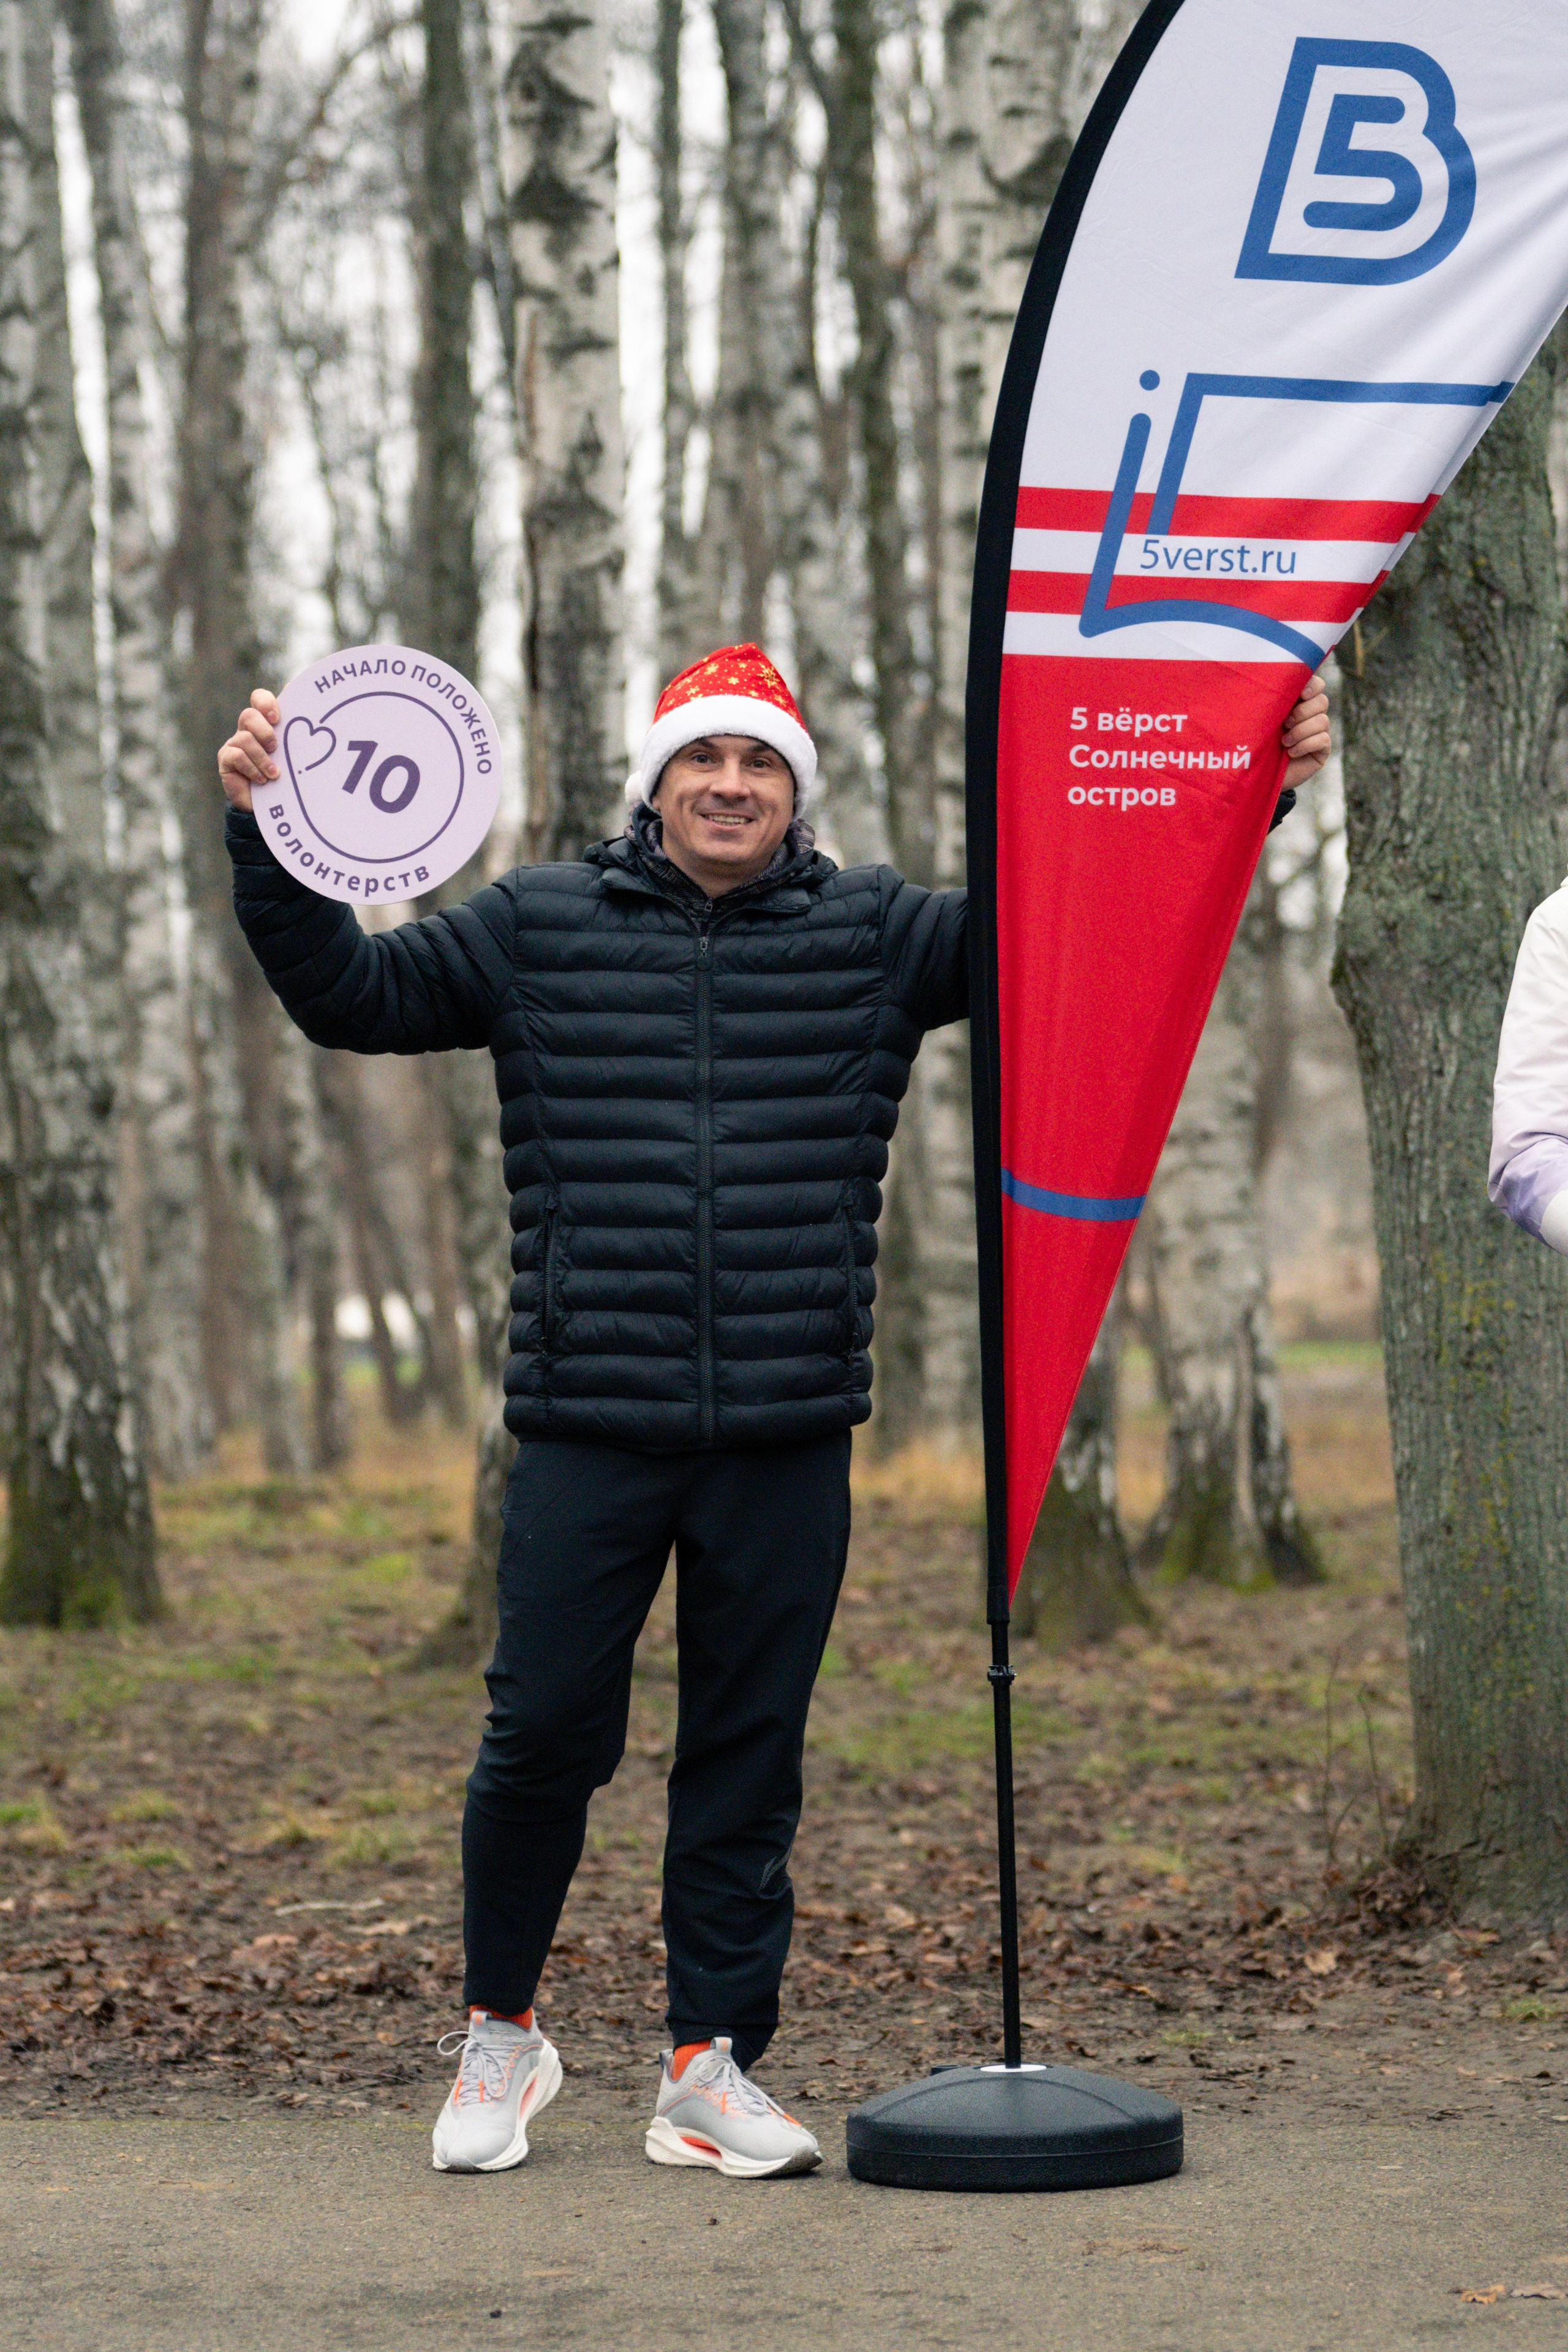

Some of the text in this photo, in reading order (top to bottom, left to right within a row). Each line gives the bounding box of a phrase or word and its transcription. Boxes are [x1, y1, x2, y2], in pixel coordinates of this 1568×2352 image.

[1139, 538, 1297, 575] 5verst.ru
[314, 658, 492, 775] НАЧАЛО ПОЛОЖЕНО
[1069, 707, 1188, 738] 5 вёрст
[1069, 744, 1251, 770] Солнечный
[341, 739, 421, 815] 10
[1067, 786, 1177, 812] остров
